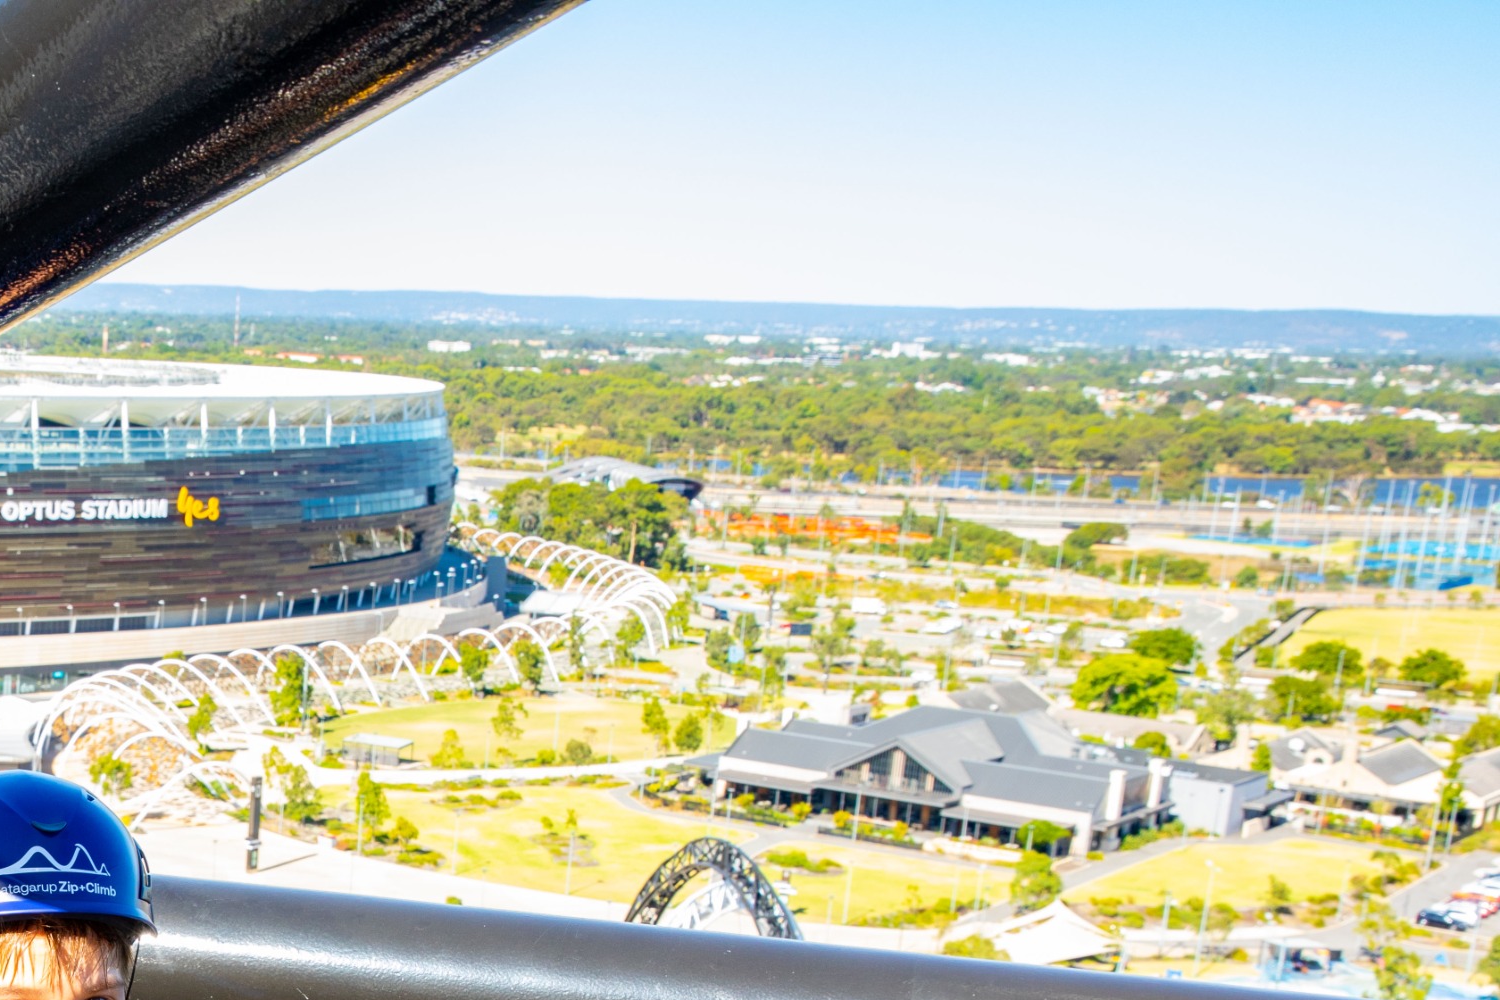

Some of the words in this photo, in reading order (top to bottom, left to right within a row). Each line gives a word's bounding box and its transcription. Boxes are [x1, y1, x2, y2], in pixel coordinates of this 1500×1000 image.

[0, 500, 76, 521] OPTUS
[81, 498, 169, 520] STADIUM
[58, 881, 117, 897] Zip+Climb
